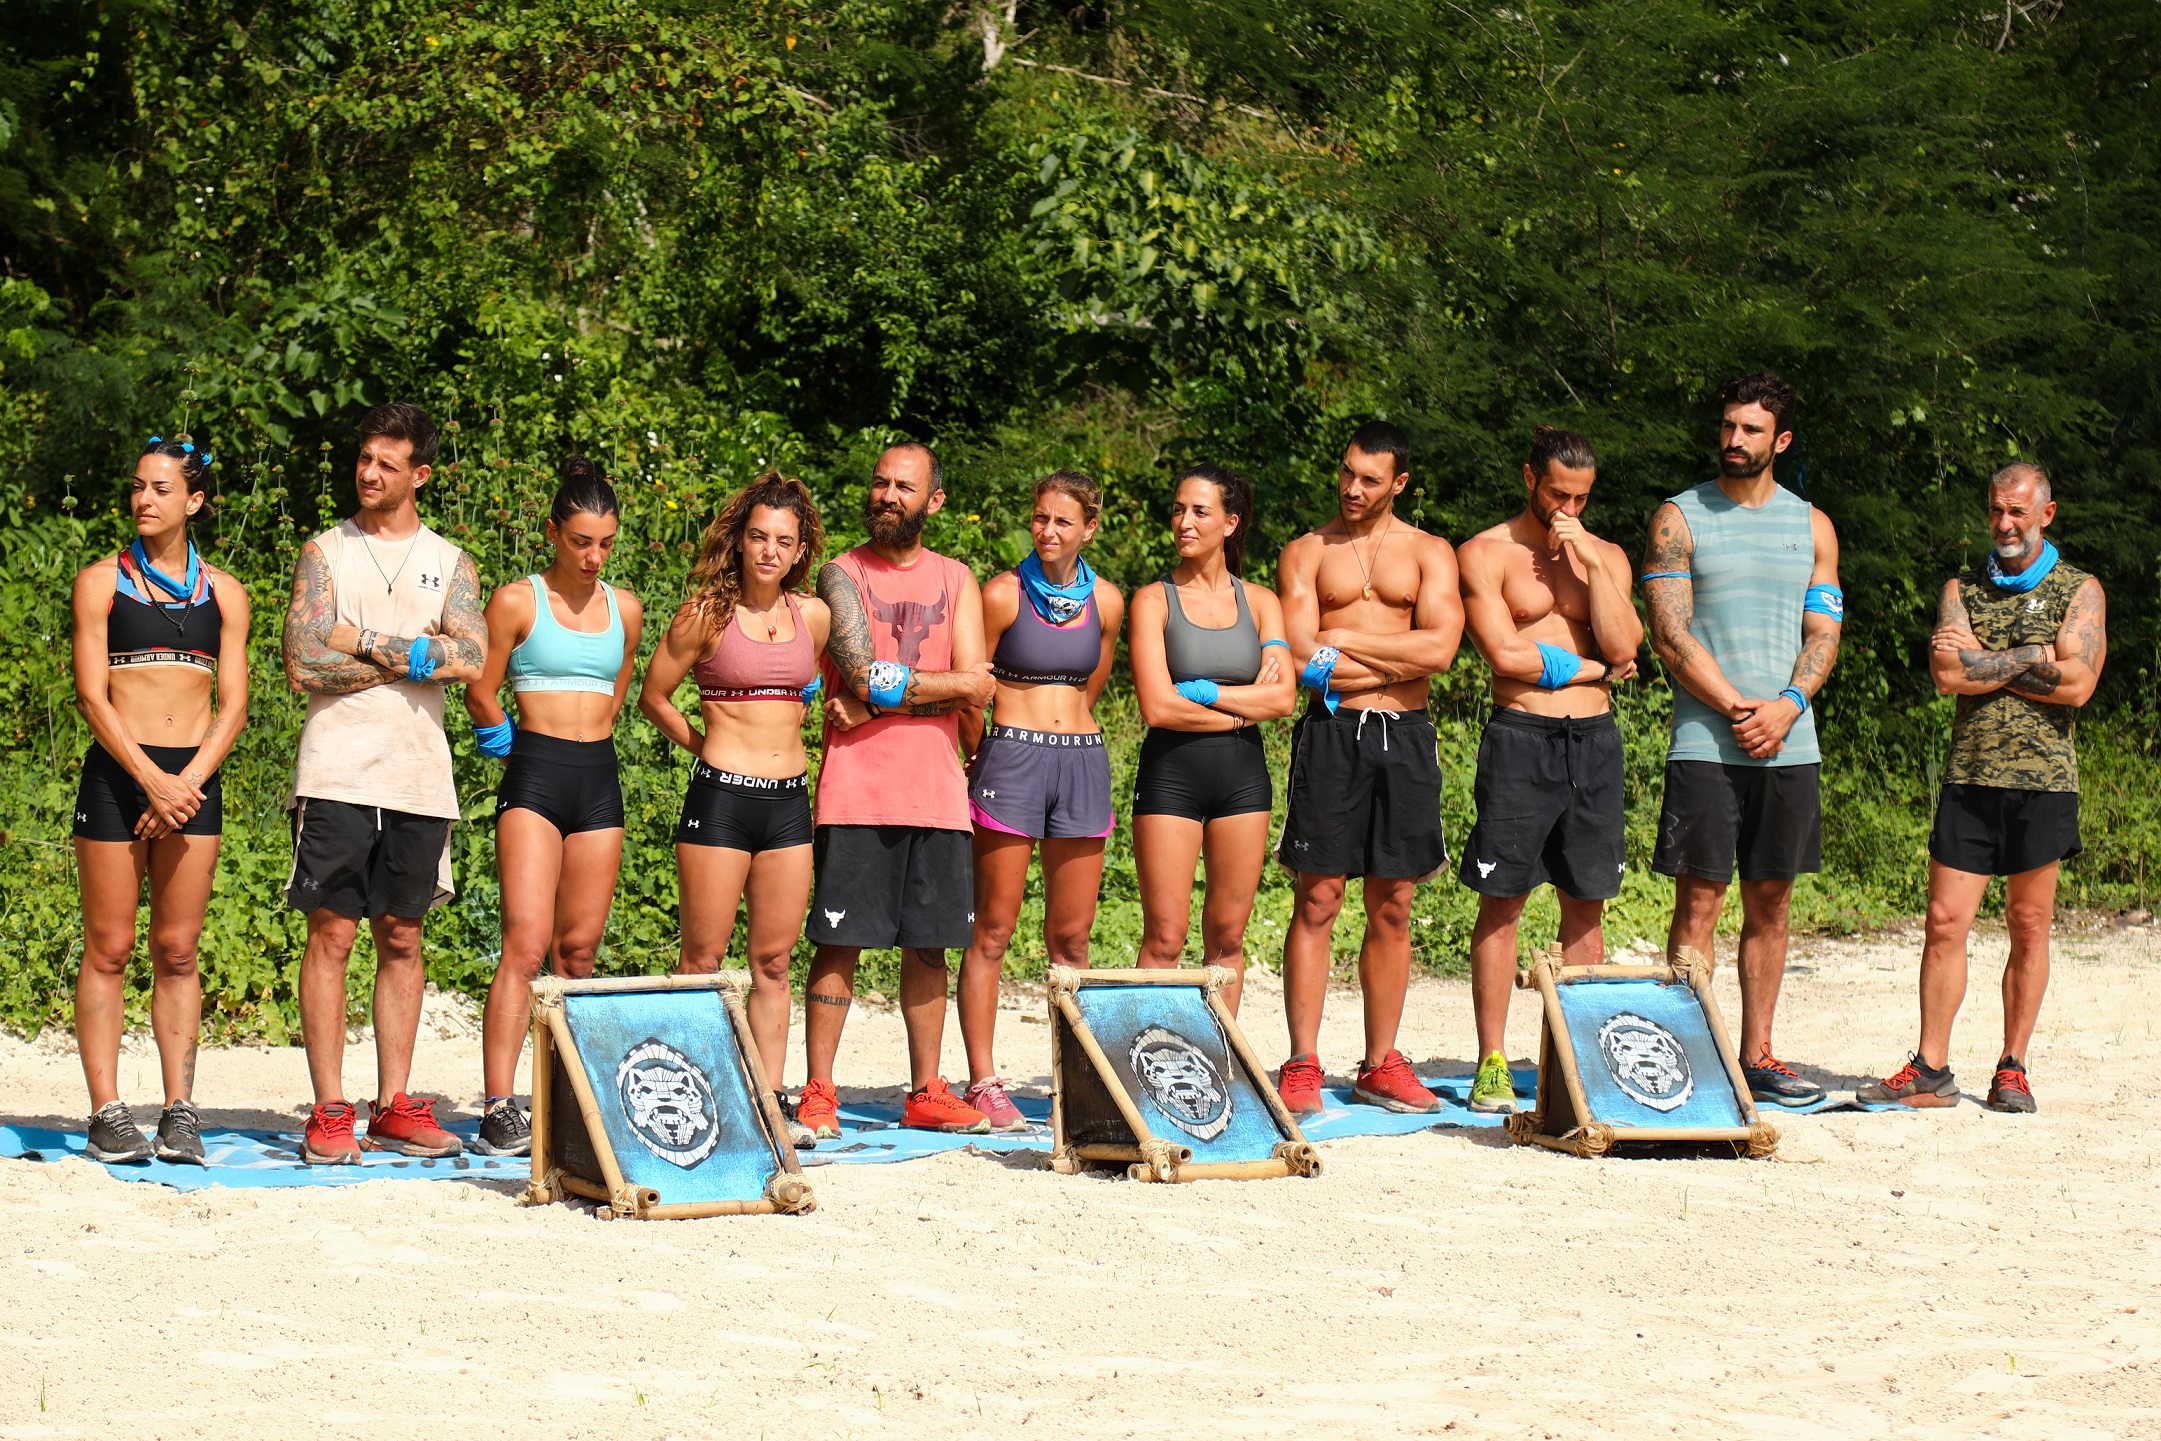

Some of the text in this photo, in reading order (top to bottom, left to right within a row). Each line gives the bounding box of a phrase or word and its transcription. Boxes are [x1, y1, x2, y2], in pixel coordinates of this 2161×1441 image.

[156, 652, 176, 661] UNDER
[550, 679, 598, 688] ARMOUR
[748, 688, 787, 696] UNDER
[719, 772, 779, 790] UNDER
